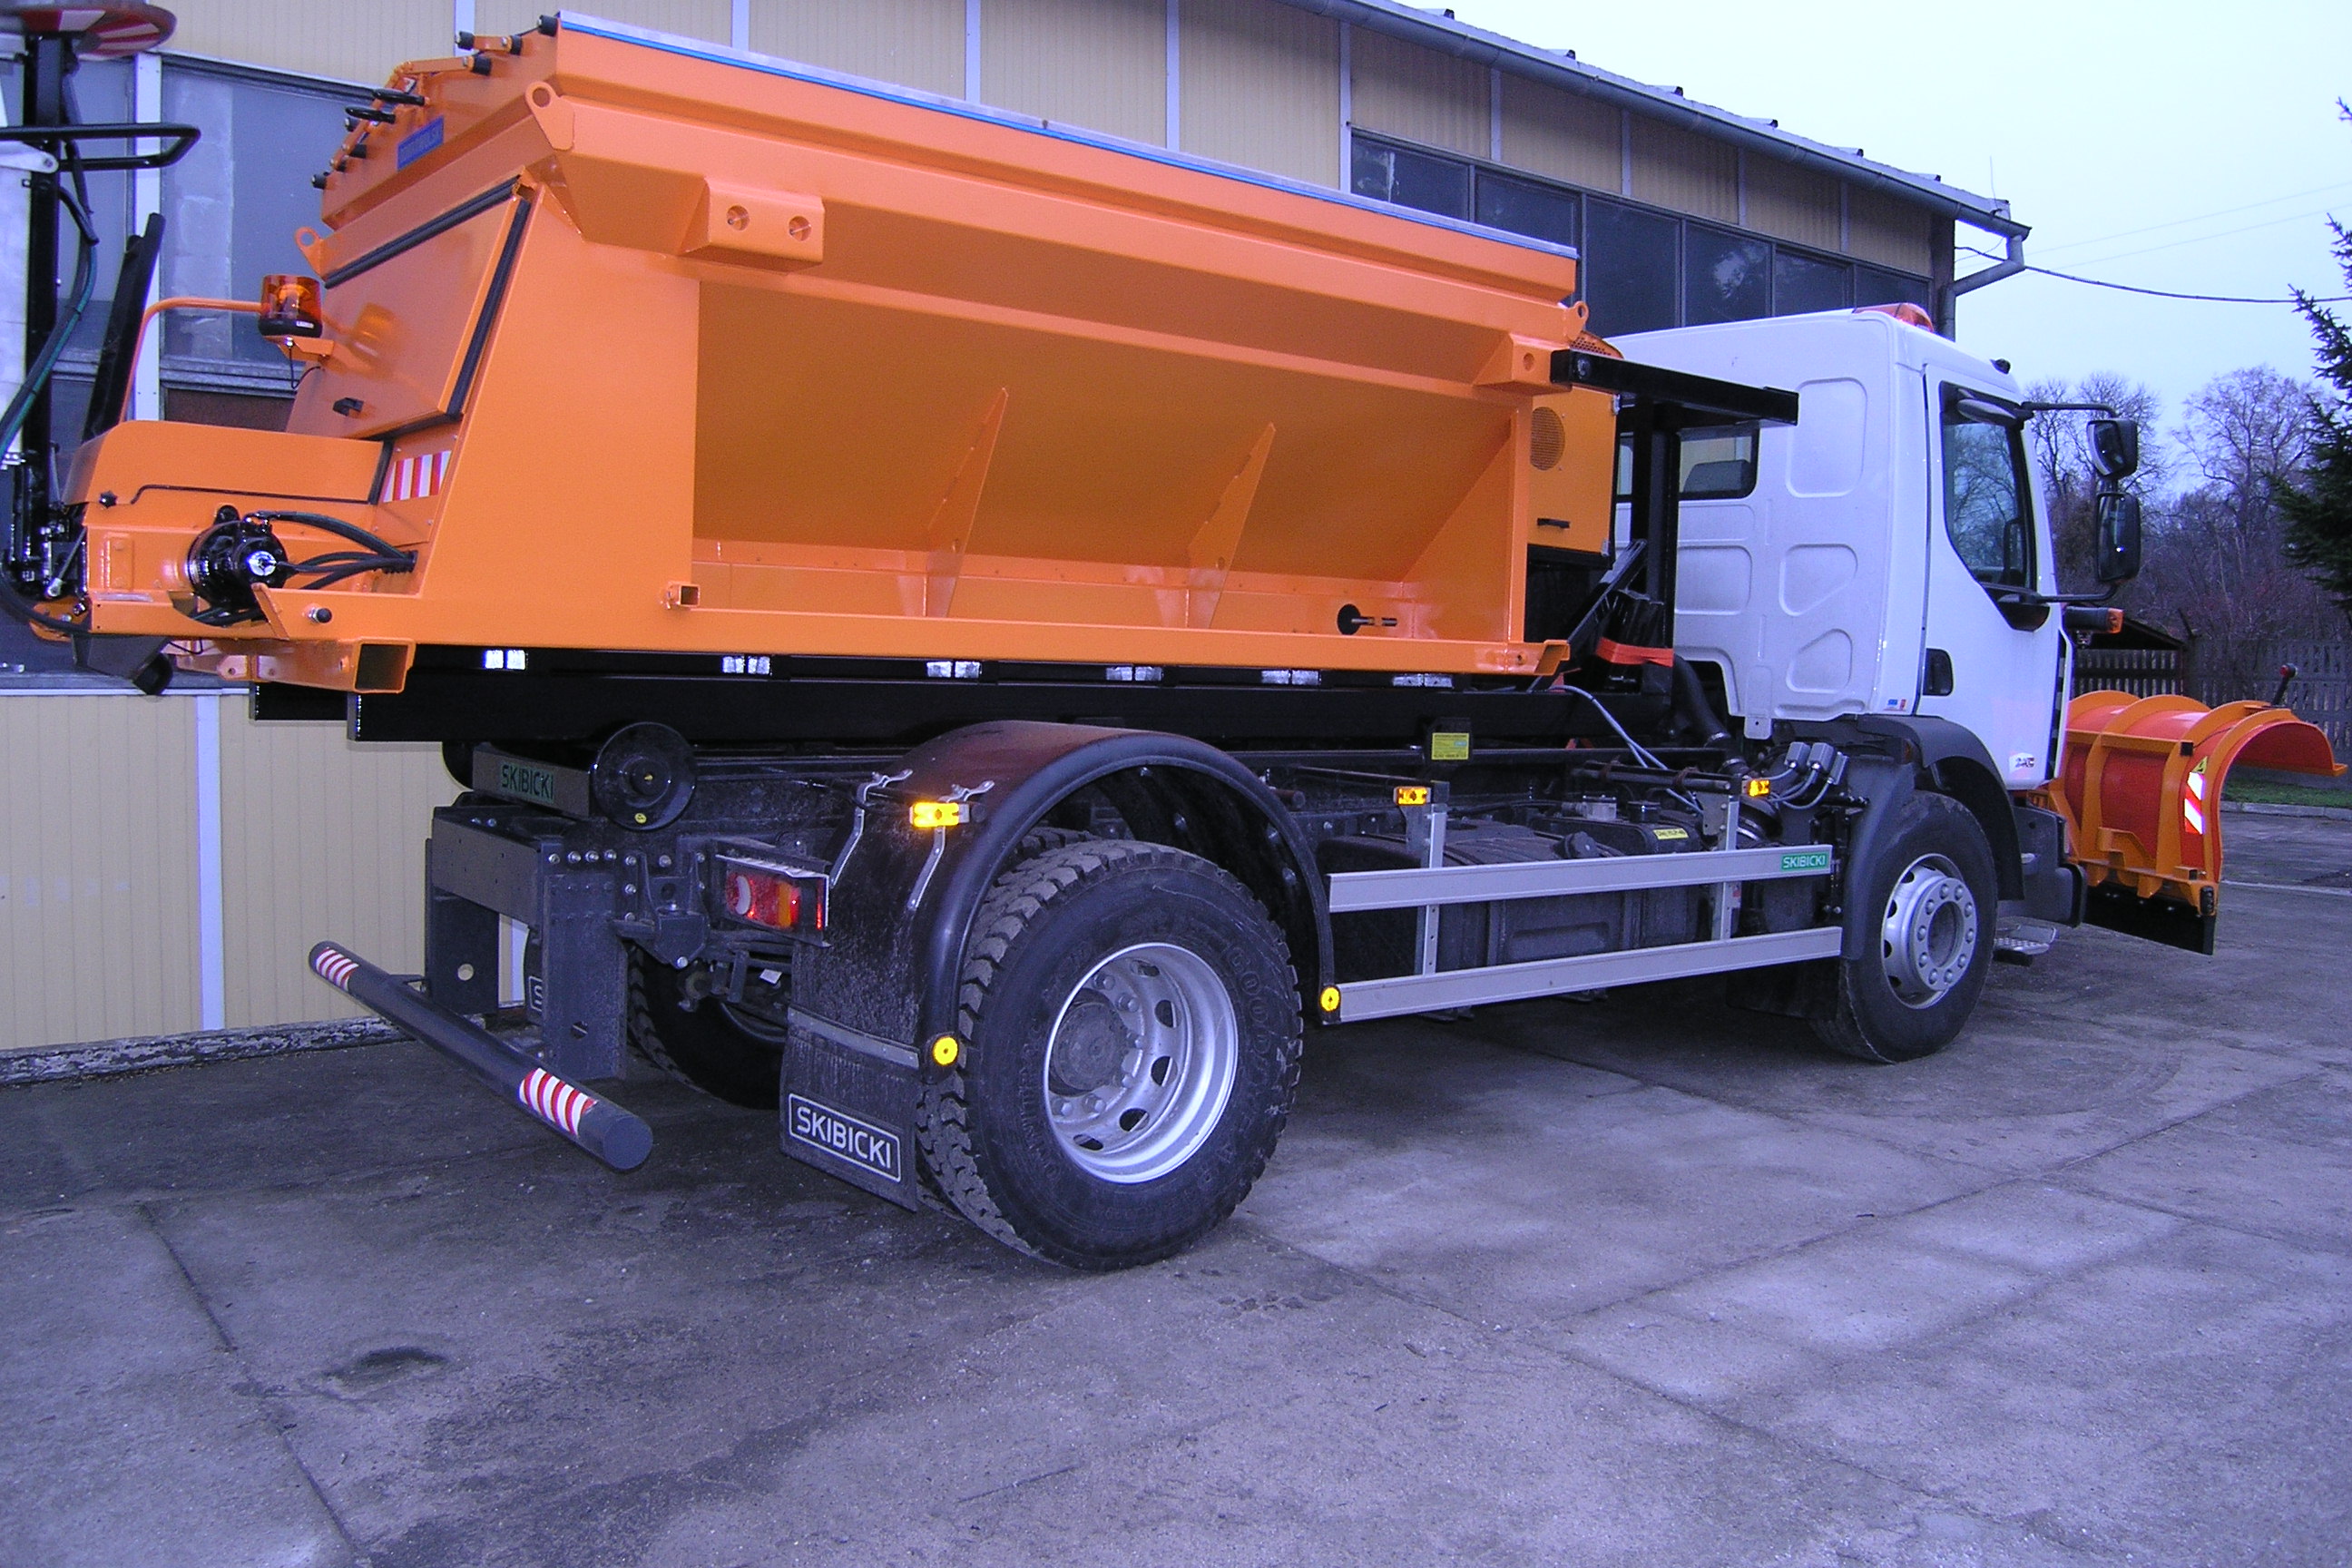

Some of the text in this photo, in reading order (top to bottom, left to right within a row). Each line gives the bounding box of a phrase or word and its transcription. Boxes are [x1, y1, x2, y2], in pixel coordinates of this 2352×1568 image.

[502, 764, 554, 800] SKIBICKI
[1783, 855, 1826, 868] SKIBICKI
[797, 1106, 891, 1169] SKIBICKI
